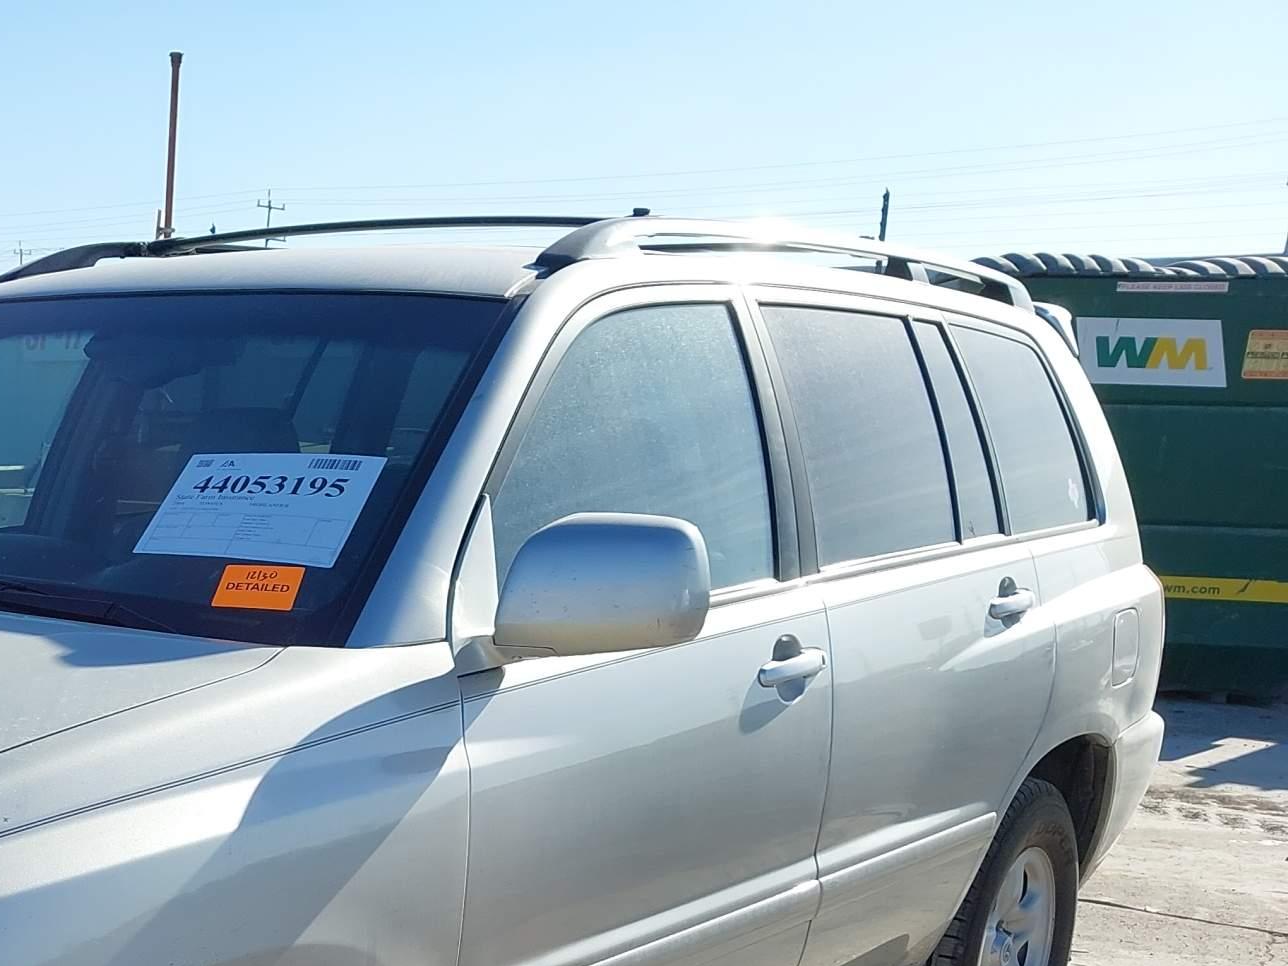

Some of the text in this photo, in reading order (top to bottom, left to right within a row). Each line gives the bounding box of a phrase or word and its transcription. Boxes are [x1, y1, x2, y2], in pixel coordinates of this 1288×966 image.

[1096, 336, 1207, 370] WM
[193, 475, 350, 497] 44053195
[225, 582, 290, 593] DETAILED
[1164, 584, 1220, 595] wm.com
